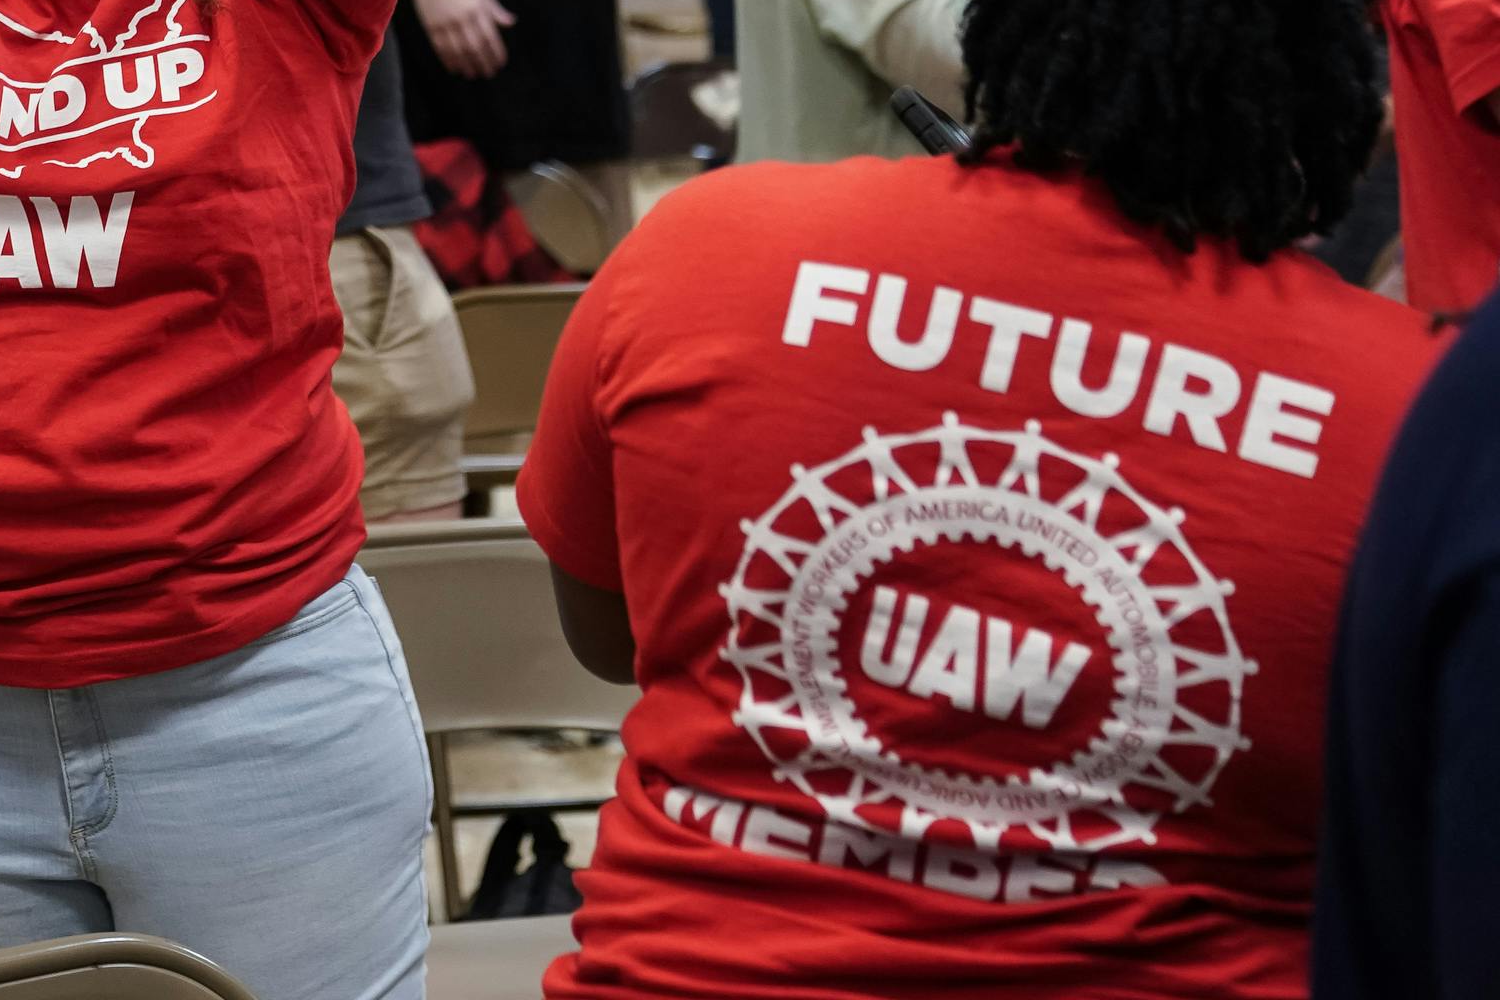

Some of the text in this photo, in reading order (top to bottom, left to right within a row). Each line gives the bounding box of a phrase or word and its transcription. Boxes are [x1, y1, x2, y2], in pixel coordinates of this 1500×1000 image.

[102, 47, 204, 109] UP
[782, 261, 1334, 478] FUTURE
[866, 511, 898, 538] OF
[904, 501, 1009, 525] AMERICA
[1016, 511, 1100, 567] UNITED
[798, 529, 869, 616] WORKERS
[860, 586, 1091, 728] UAW
